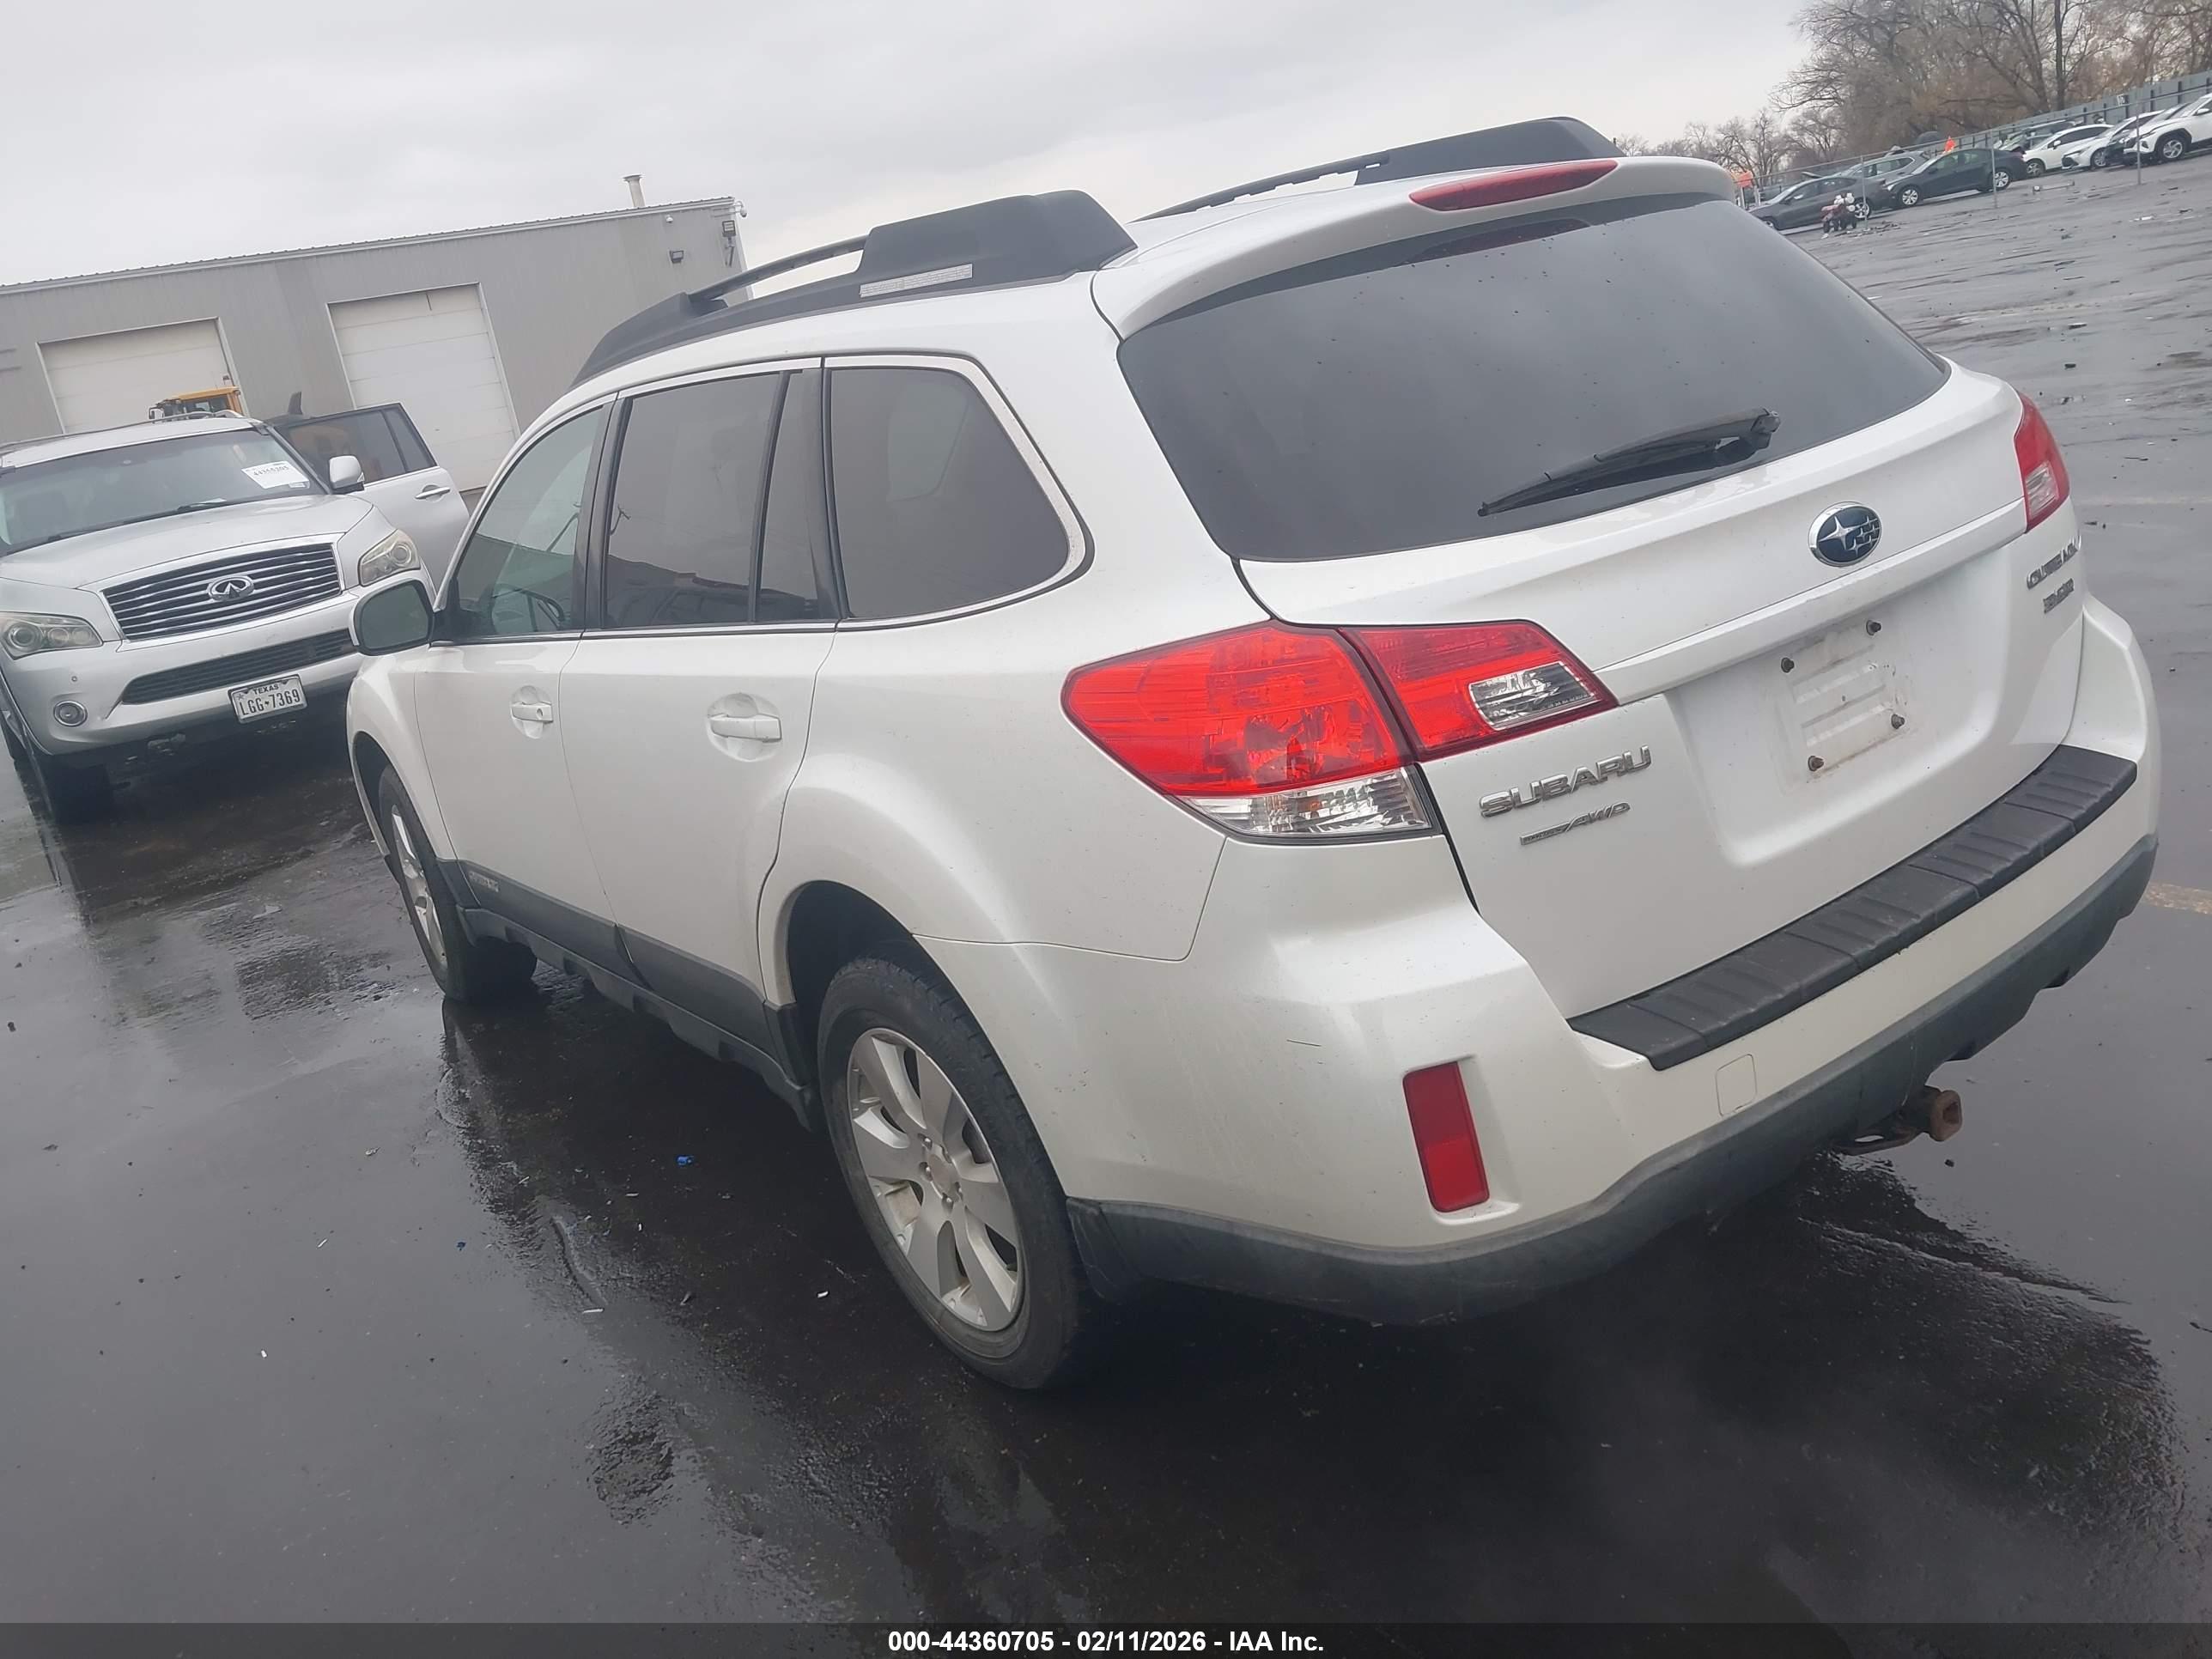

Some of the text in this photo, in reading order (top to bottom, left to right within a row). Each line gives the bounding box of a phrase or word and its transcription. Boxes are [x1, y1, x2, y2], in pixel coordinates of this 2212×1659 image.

[252, 684, 279, 695] TEXAS
[1479, 744, 1652, 818] SUBARU
[1563, 801, 1632, 833] AWD
